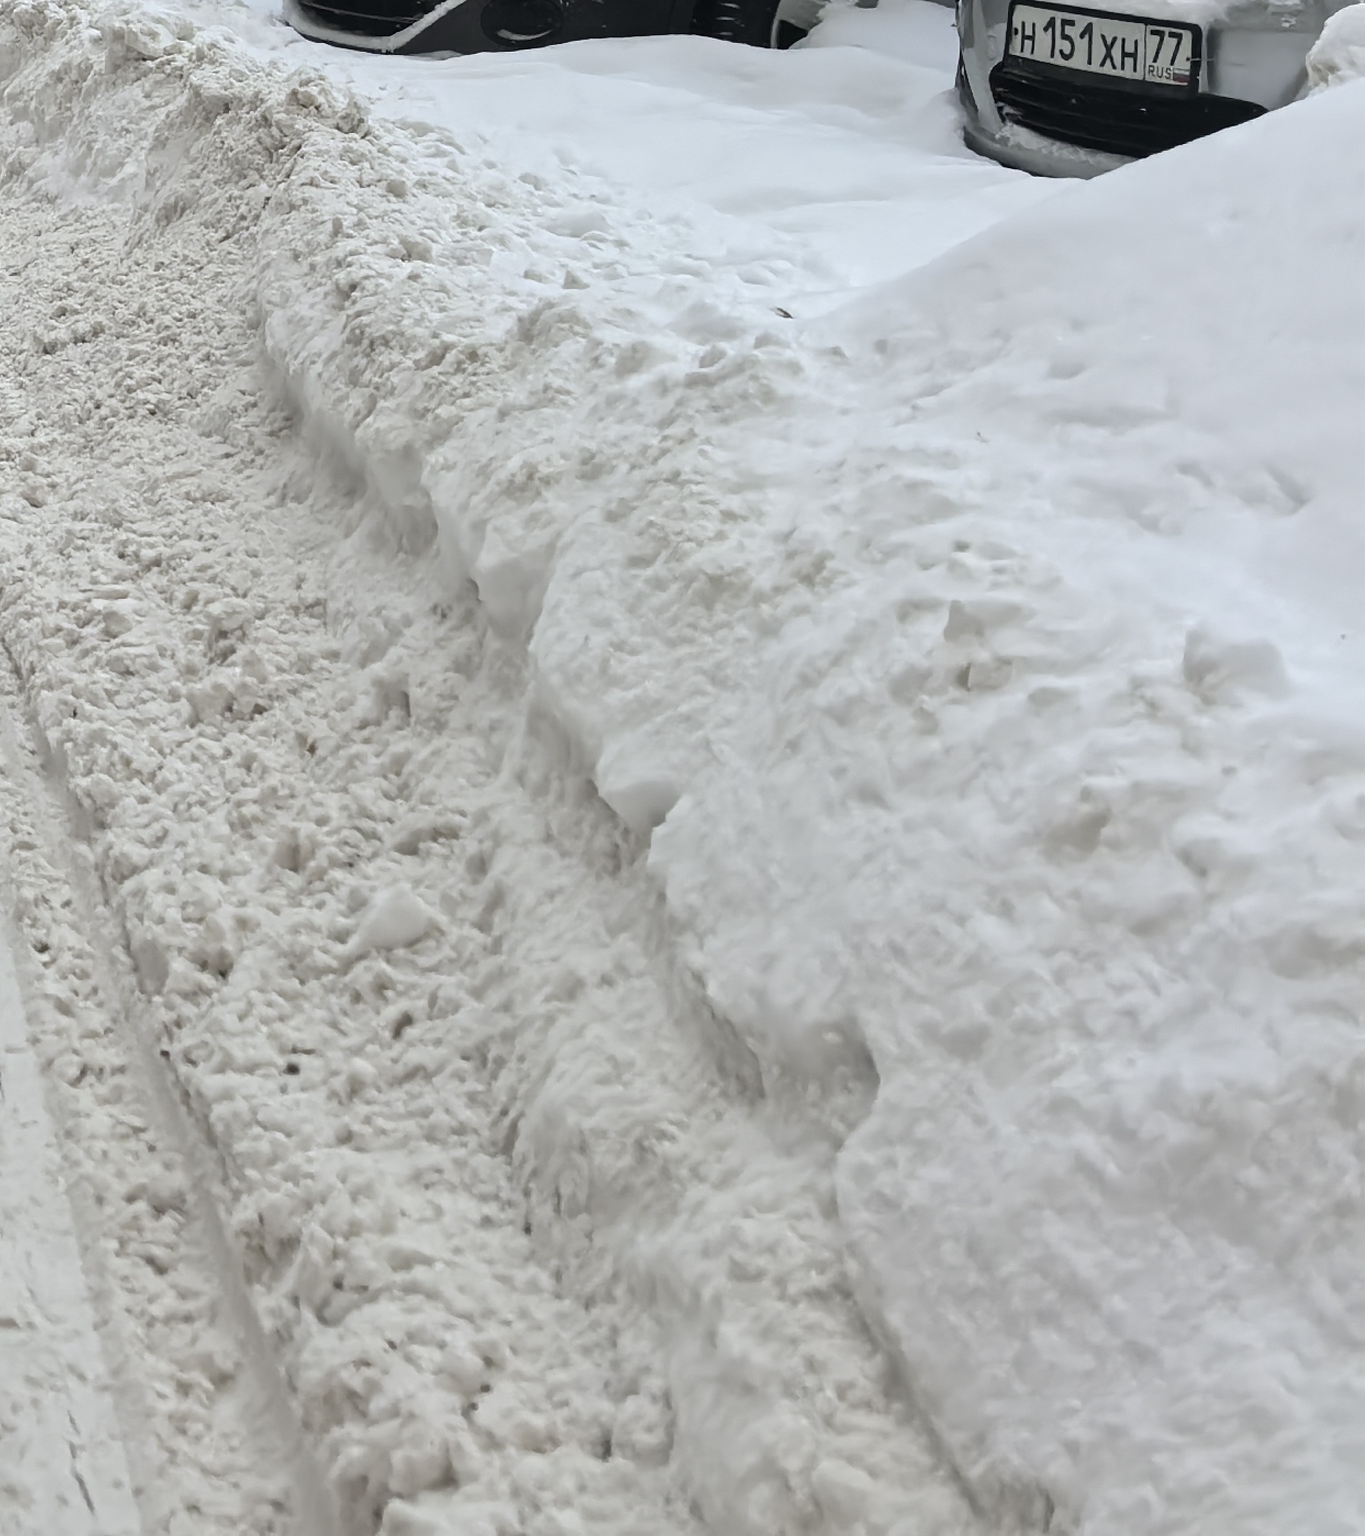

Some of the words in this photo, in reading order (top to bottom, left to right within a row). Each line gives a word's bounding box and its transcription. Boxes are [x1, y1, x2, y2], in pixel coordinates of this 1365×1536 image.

[1020, 16, 1139, 73] Н151ХН
[1149, 29, 1183, 66] 77
[1147, 64, 1172, 80] RUS
